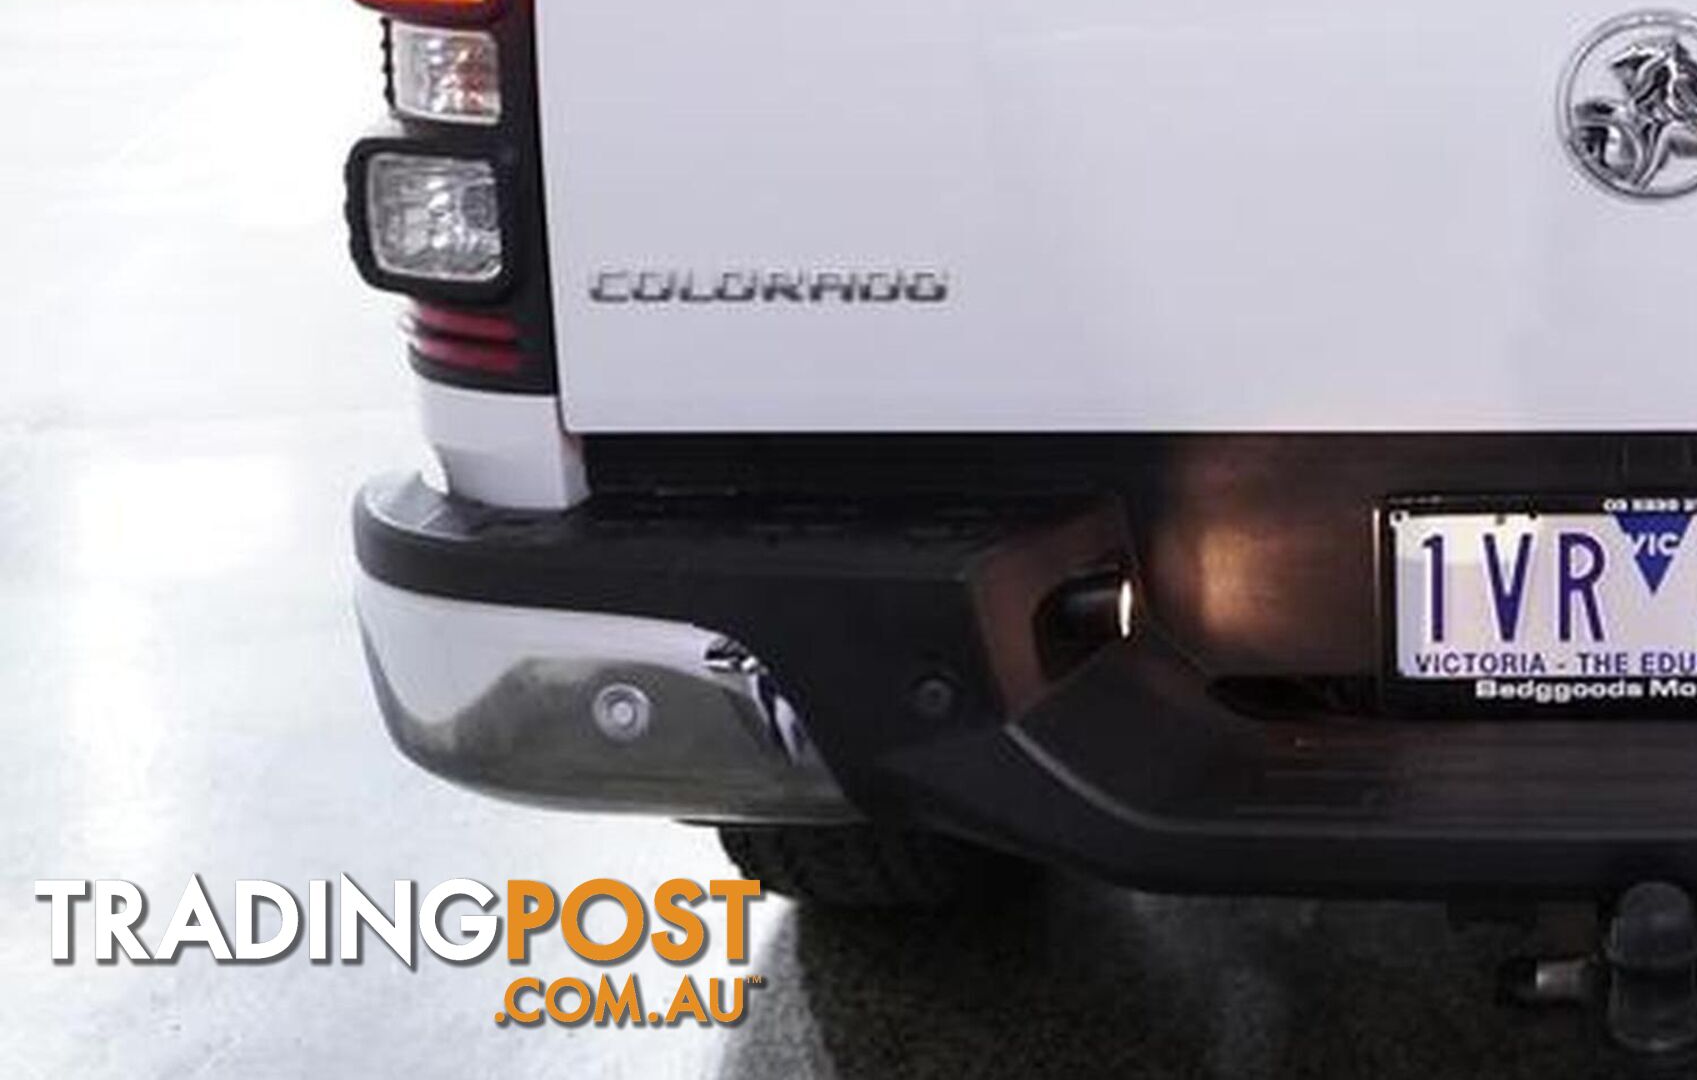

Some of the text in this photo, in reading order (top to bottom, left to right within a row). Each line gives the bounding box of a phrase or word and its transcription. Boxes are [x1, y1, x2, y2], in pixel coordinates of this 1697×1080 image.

[589, 271, 948, 302] COLORADO
[1629, 532, 1681, 555] VIC
[1422, 533, 1606, 643] 1VR
[1415, 652, 1547, 674] VICTORIA
[1577, 653, 1628, 673] THE
